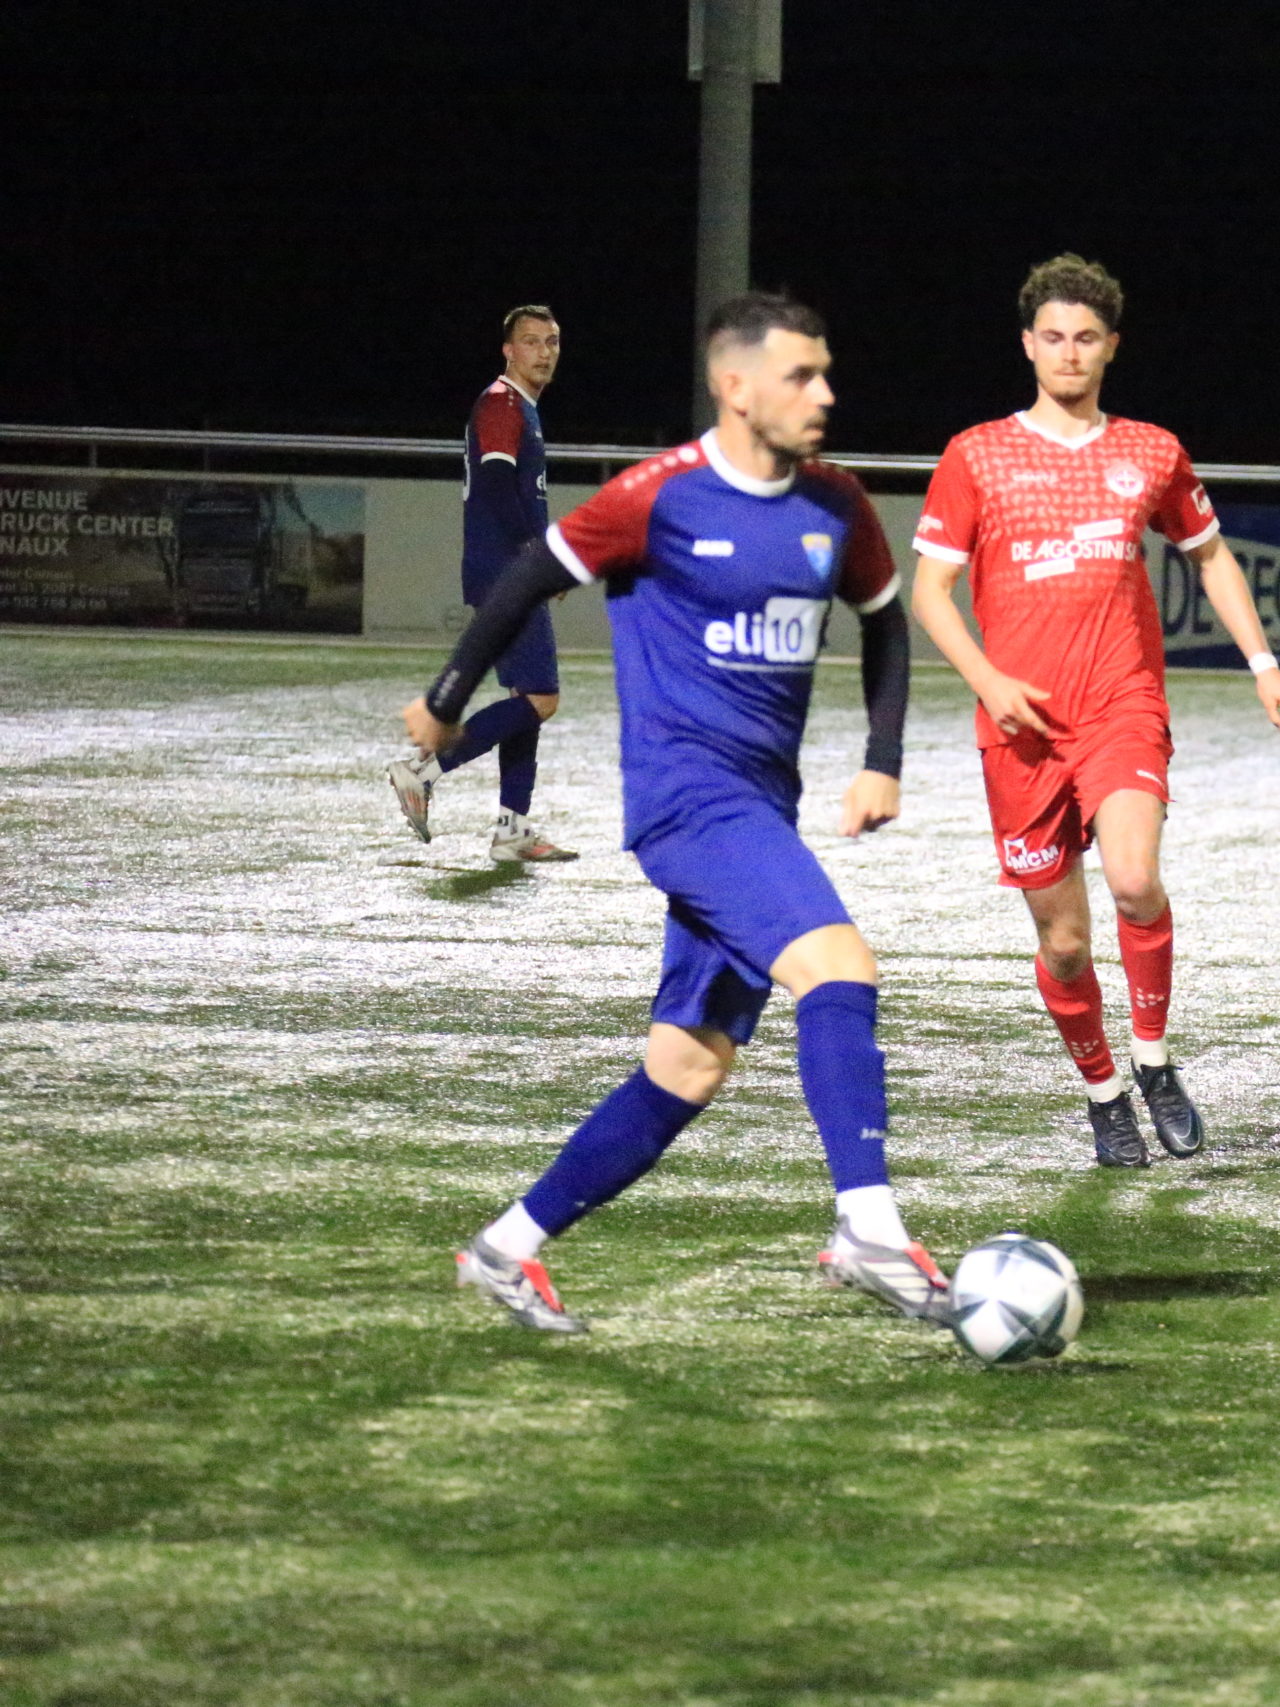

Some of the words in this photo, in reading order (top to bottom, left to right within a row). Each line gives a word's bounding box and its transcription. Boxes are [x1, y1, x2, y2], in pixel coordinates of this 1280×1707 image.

[77, 515, 174, 536] CENTER
[1011, 541, 1032, 562] DE
[1032, 540, 1123, 561] AGOSTINI
[1010, 844, 1059, 870] MCM
